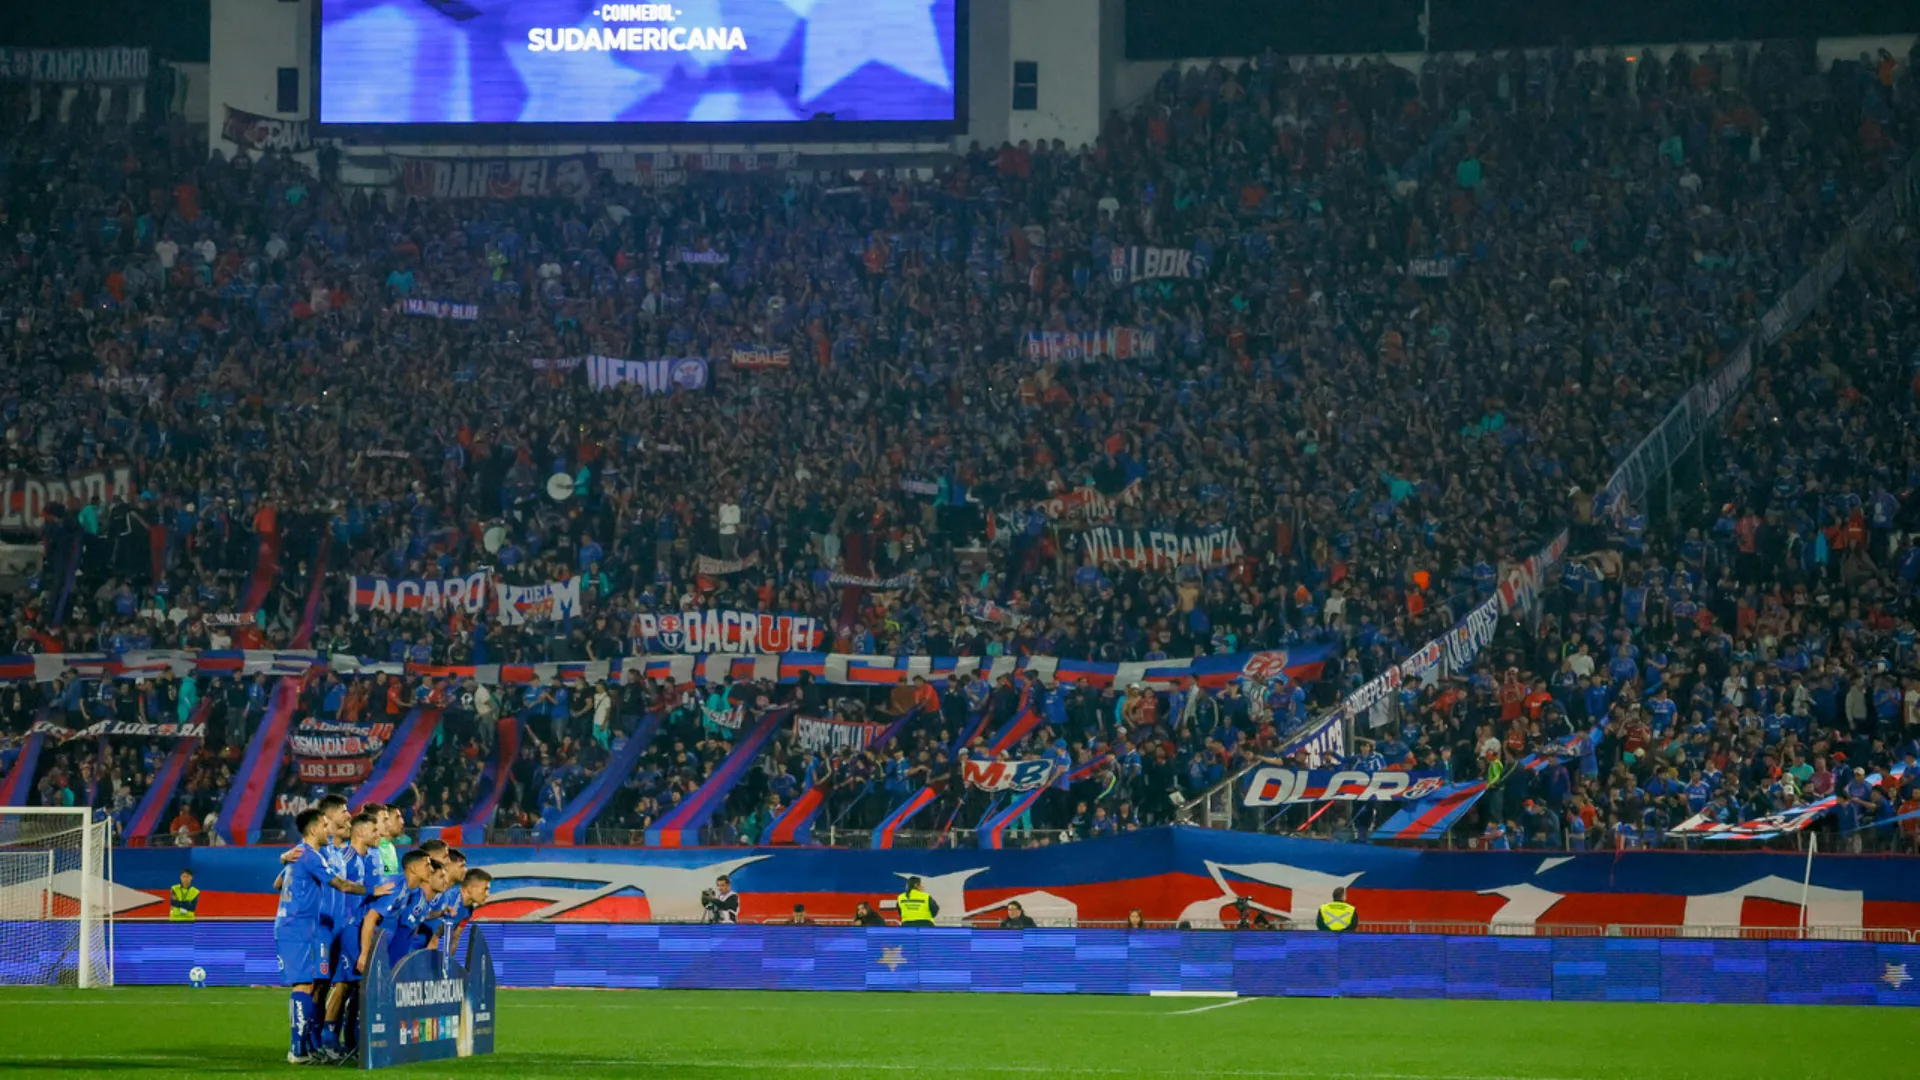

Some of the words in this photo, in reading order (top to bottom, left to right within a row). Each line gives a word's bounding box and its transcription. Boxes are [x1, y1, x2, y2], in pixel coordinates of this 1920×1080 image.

[527, 26, 748, 52] SUDAMERICANA
[31, 47, 149, 80] KAMPANARIO
[1083, 526, 1147, 570] VILLA
[1150, 526, 1244, 570] FRANCIA
[301, 763, 326, 776] LOS
[328, 762, 355, 777] LKB
